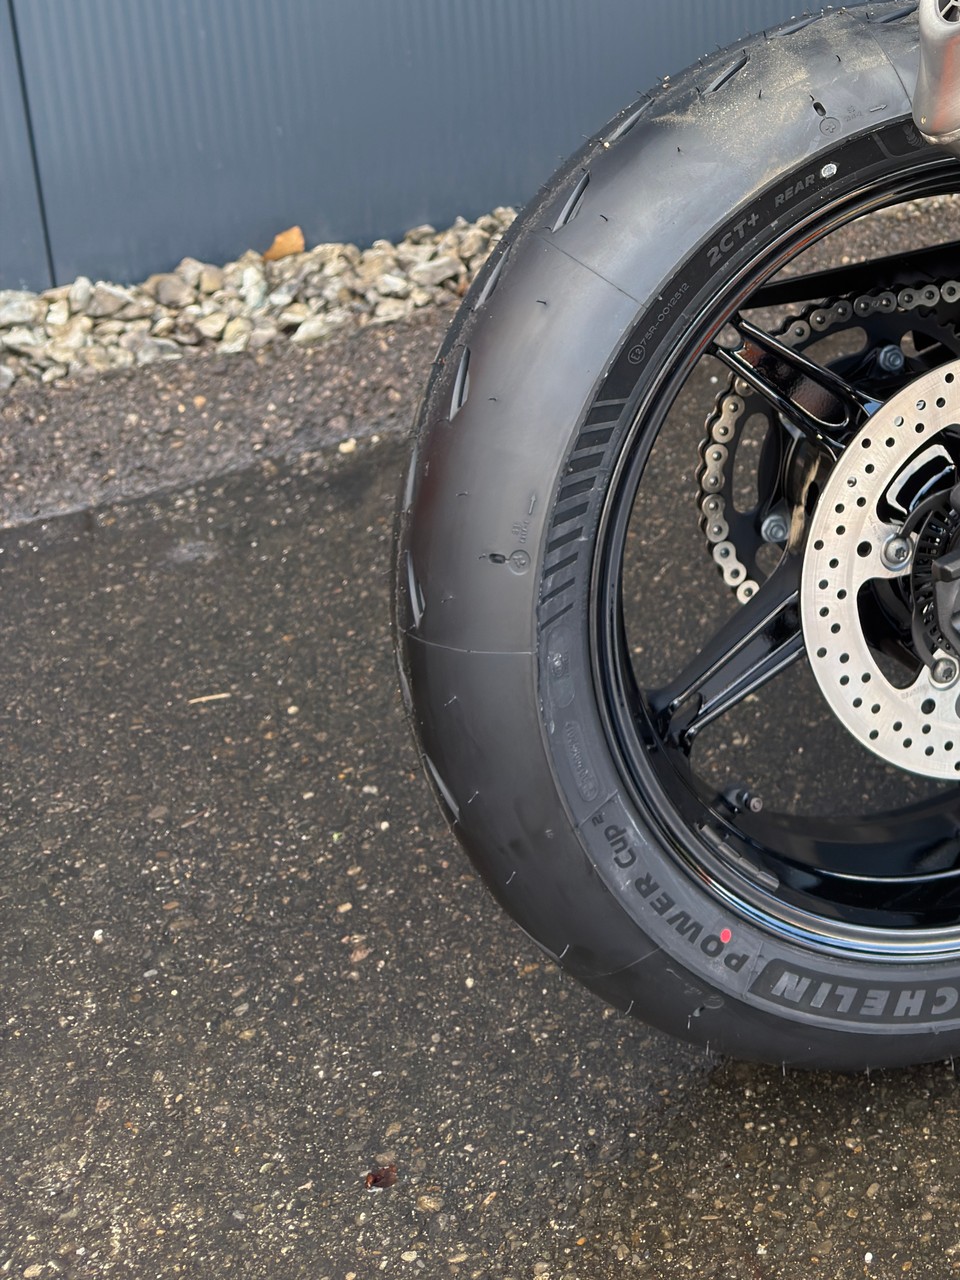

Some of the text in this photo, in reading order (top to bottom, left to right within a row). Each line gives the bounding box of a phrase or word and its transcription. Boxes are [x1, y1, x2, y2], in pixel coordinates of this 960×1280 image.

[706, 173, 815, 268] 2CT+ REAR
[634, 872, 750, 973] POWER
